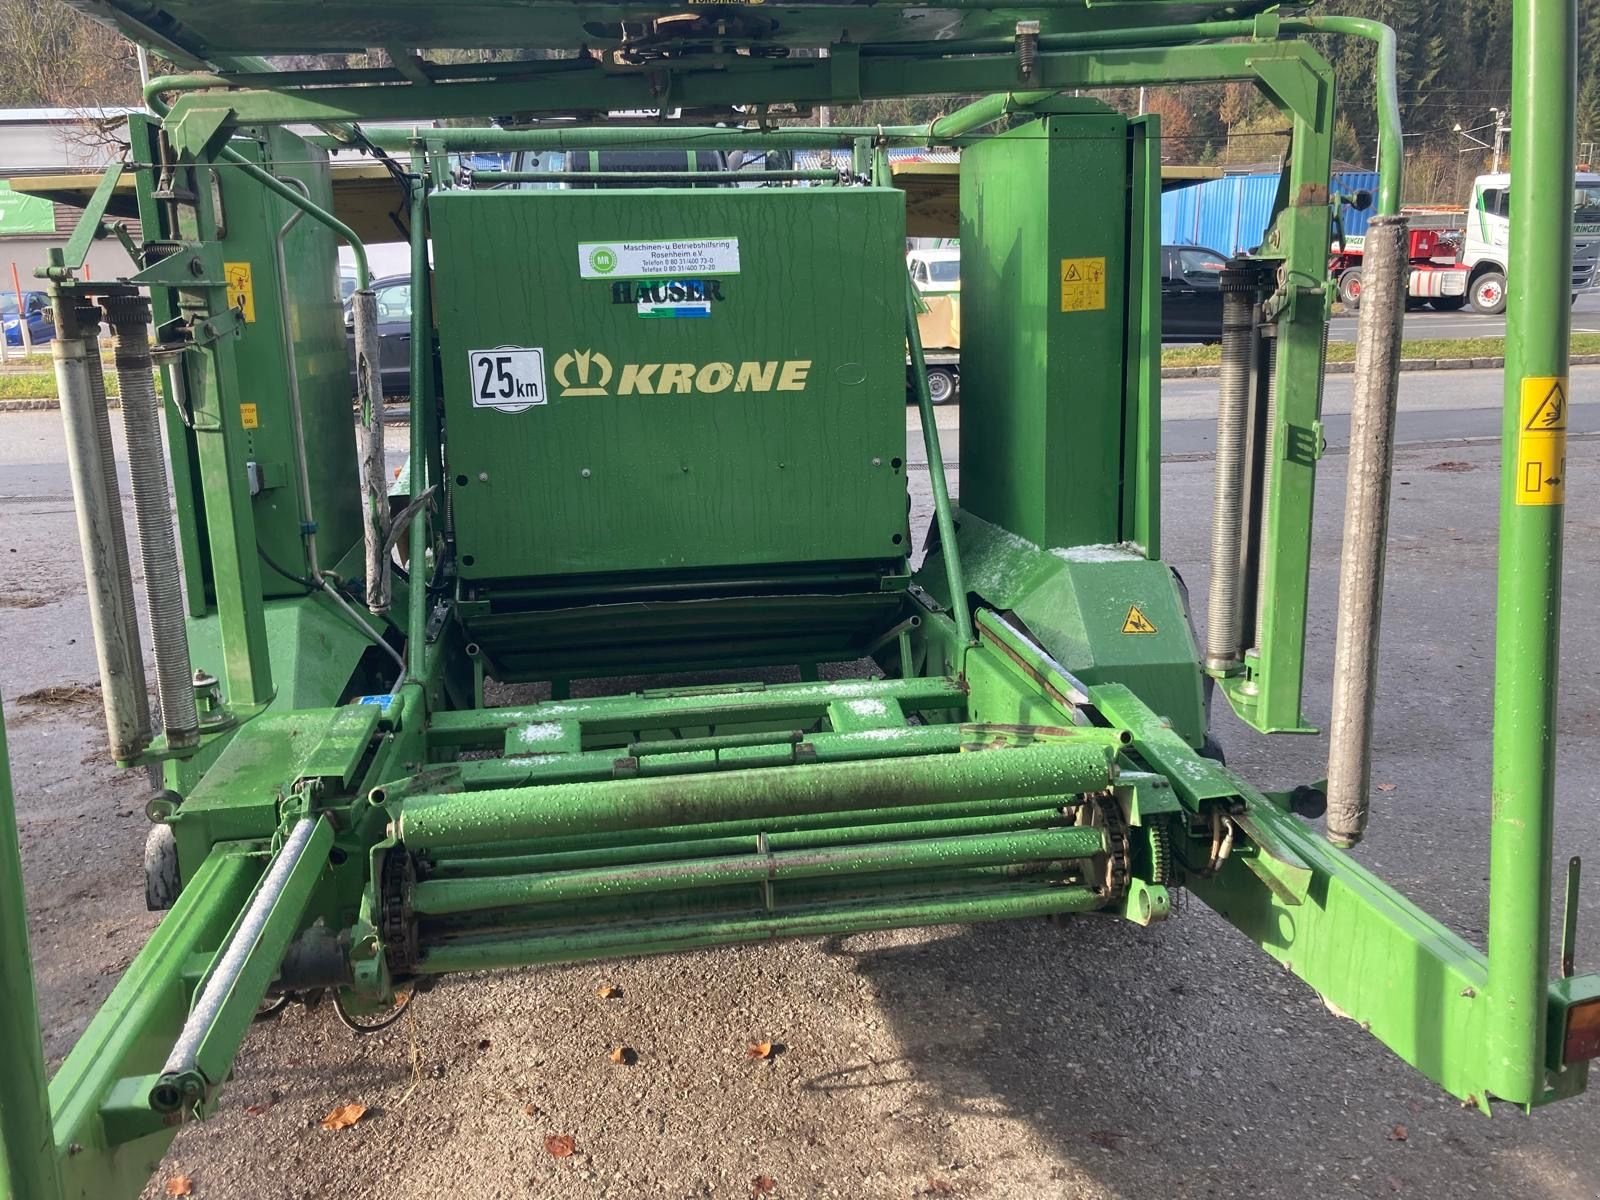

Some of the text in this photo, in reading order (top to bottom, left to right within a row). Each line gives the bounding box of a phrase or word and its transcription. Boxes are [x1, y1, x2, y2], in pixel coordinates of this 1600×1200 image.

[672, 242, 730, 250] Betriebshilfsring
[597, 256, 610, 264] MR
[612, 280, 725, 304] HAUSER
[617, 360, 812, 395] KRONE
